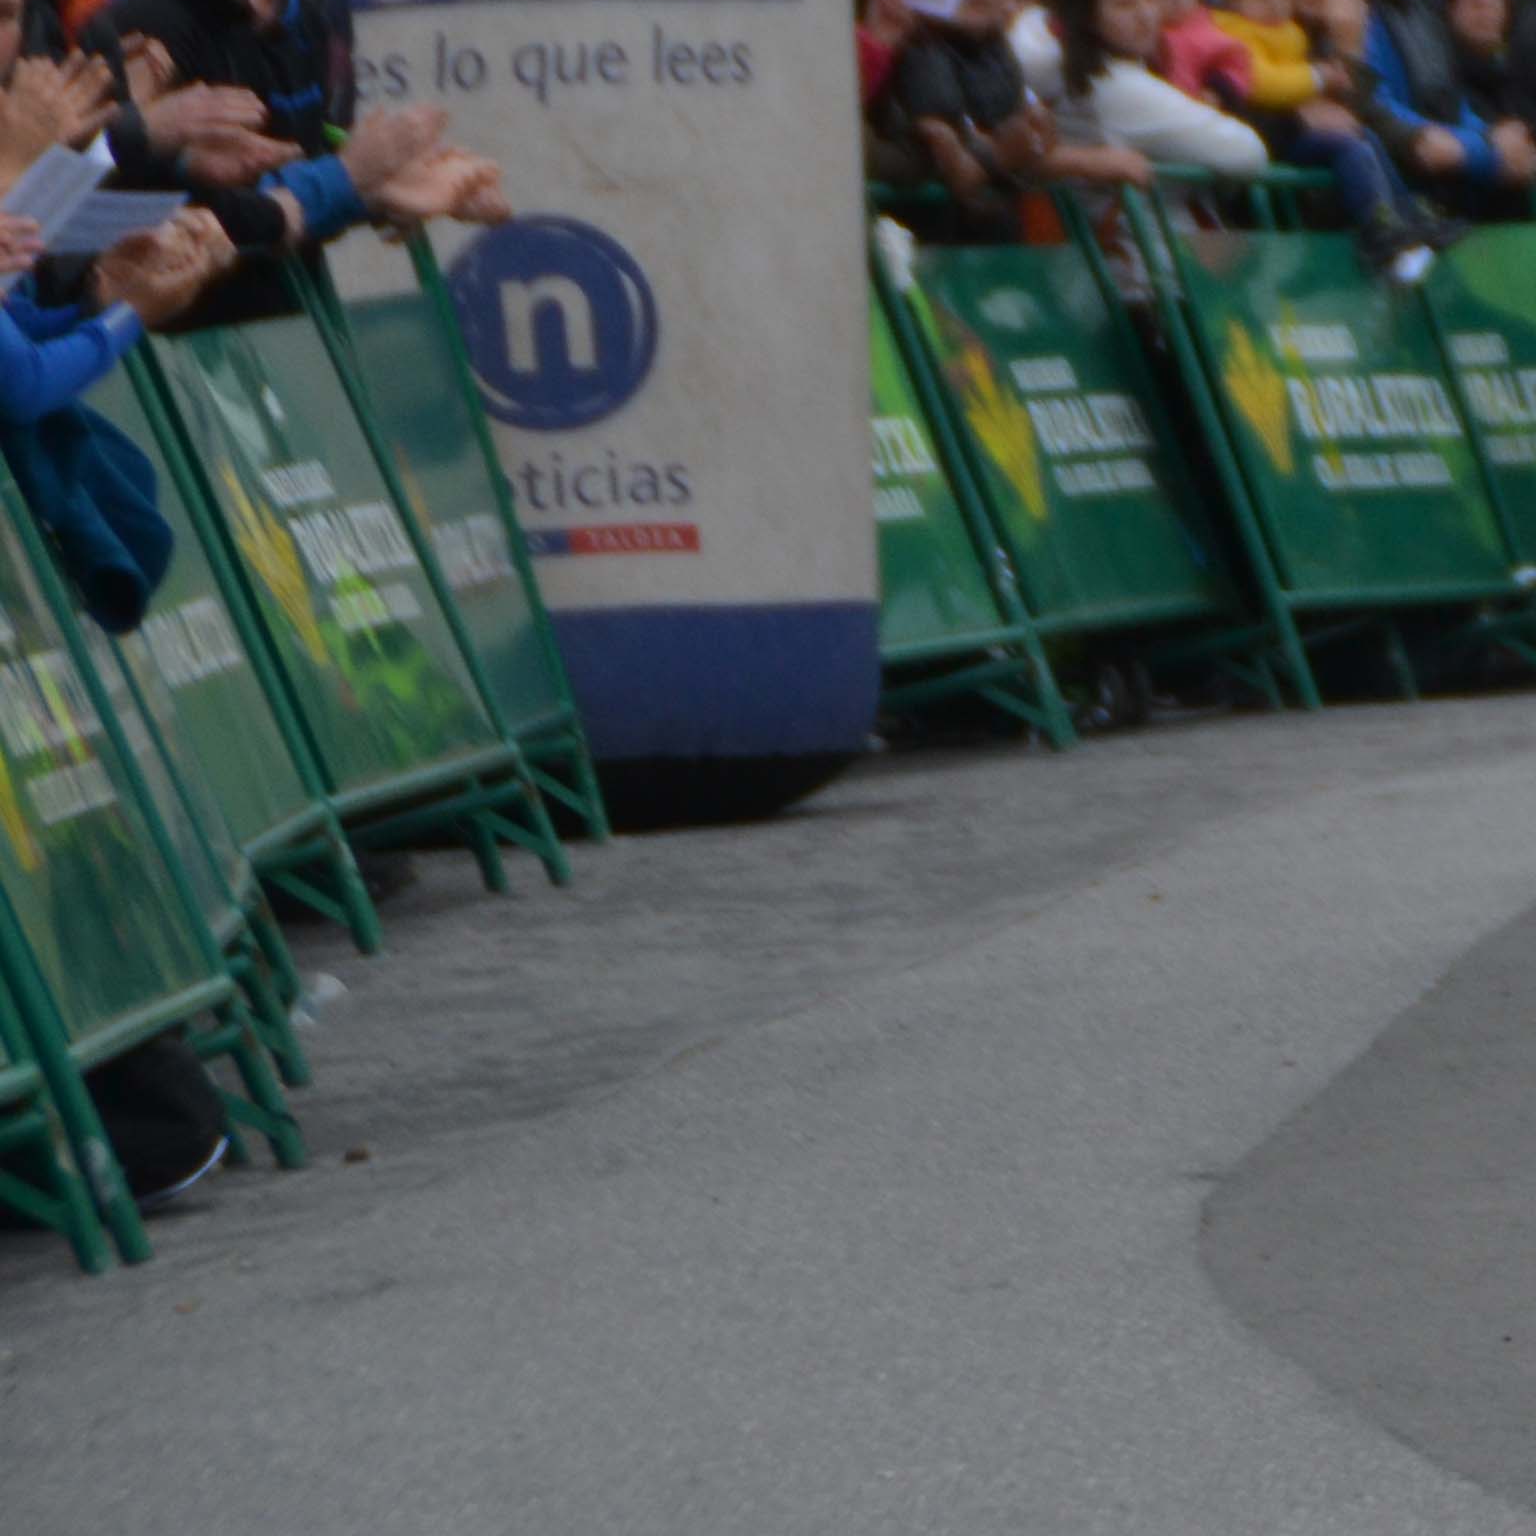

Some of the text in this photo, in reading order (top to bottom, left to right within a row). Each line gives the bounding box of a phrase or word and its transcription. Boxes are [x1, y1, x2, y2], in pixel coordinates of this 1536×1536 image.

[435, 30, 487, 92] lo
[511, 39, 628, 107] que
[655, 22, 752, 85] lees
[502, 276, 597, 372] n
[505, 449, 693, 510] ticias
